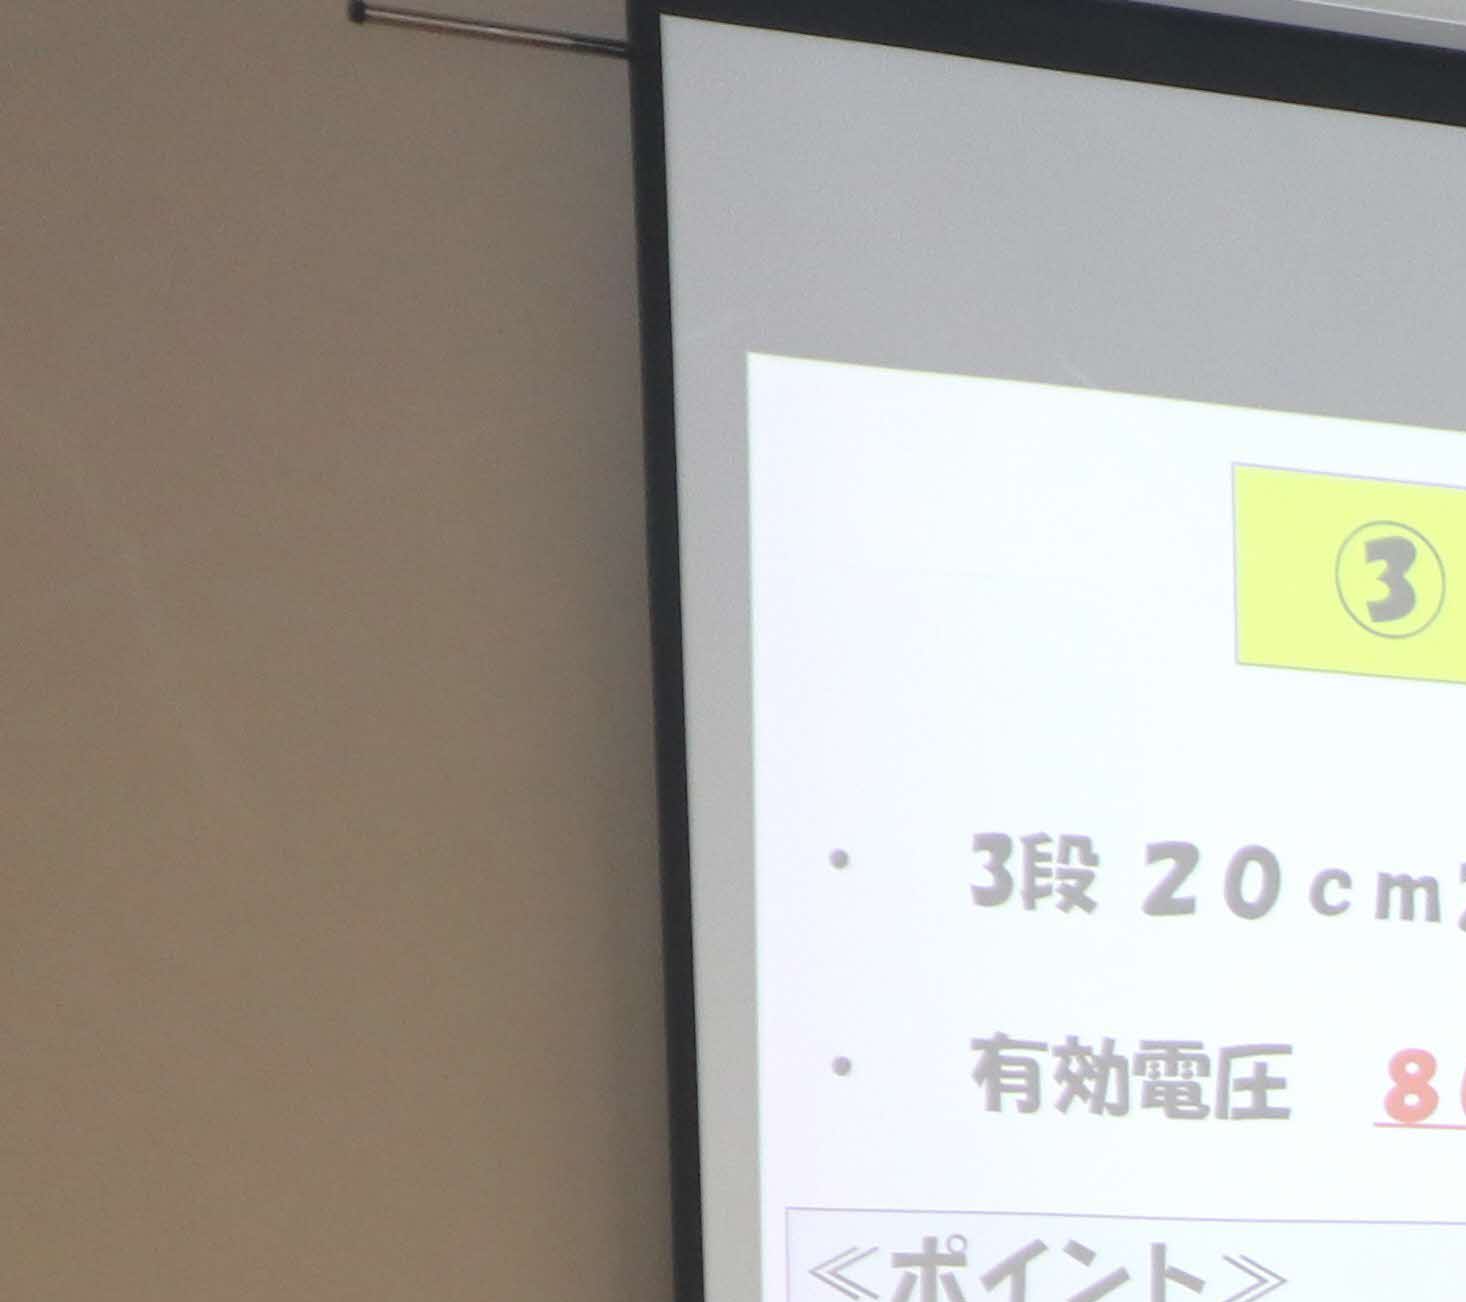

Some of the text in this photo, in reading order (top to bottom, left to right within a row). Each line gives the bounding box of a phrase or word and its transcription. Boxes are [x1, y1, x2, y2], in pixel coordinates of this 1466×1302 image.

[971, 831, 1100, 914] 3段
[971, 1031, 1292, 1121] 有効電圧
